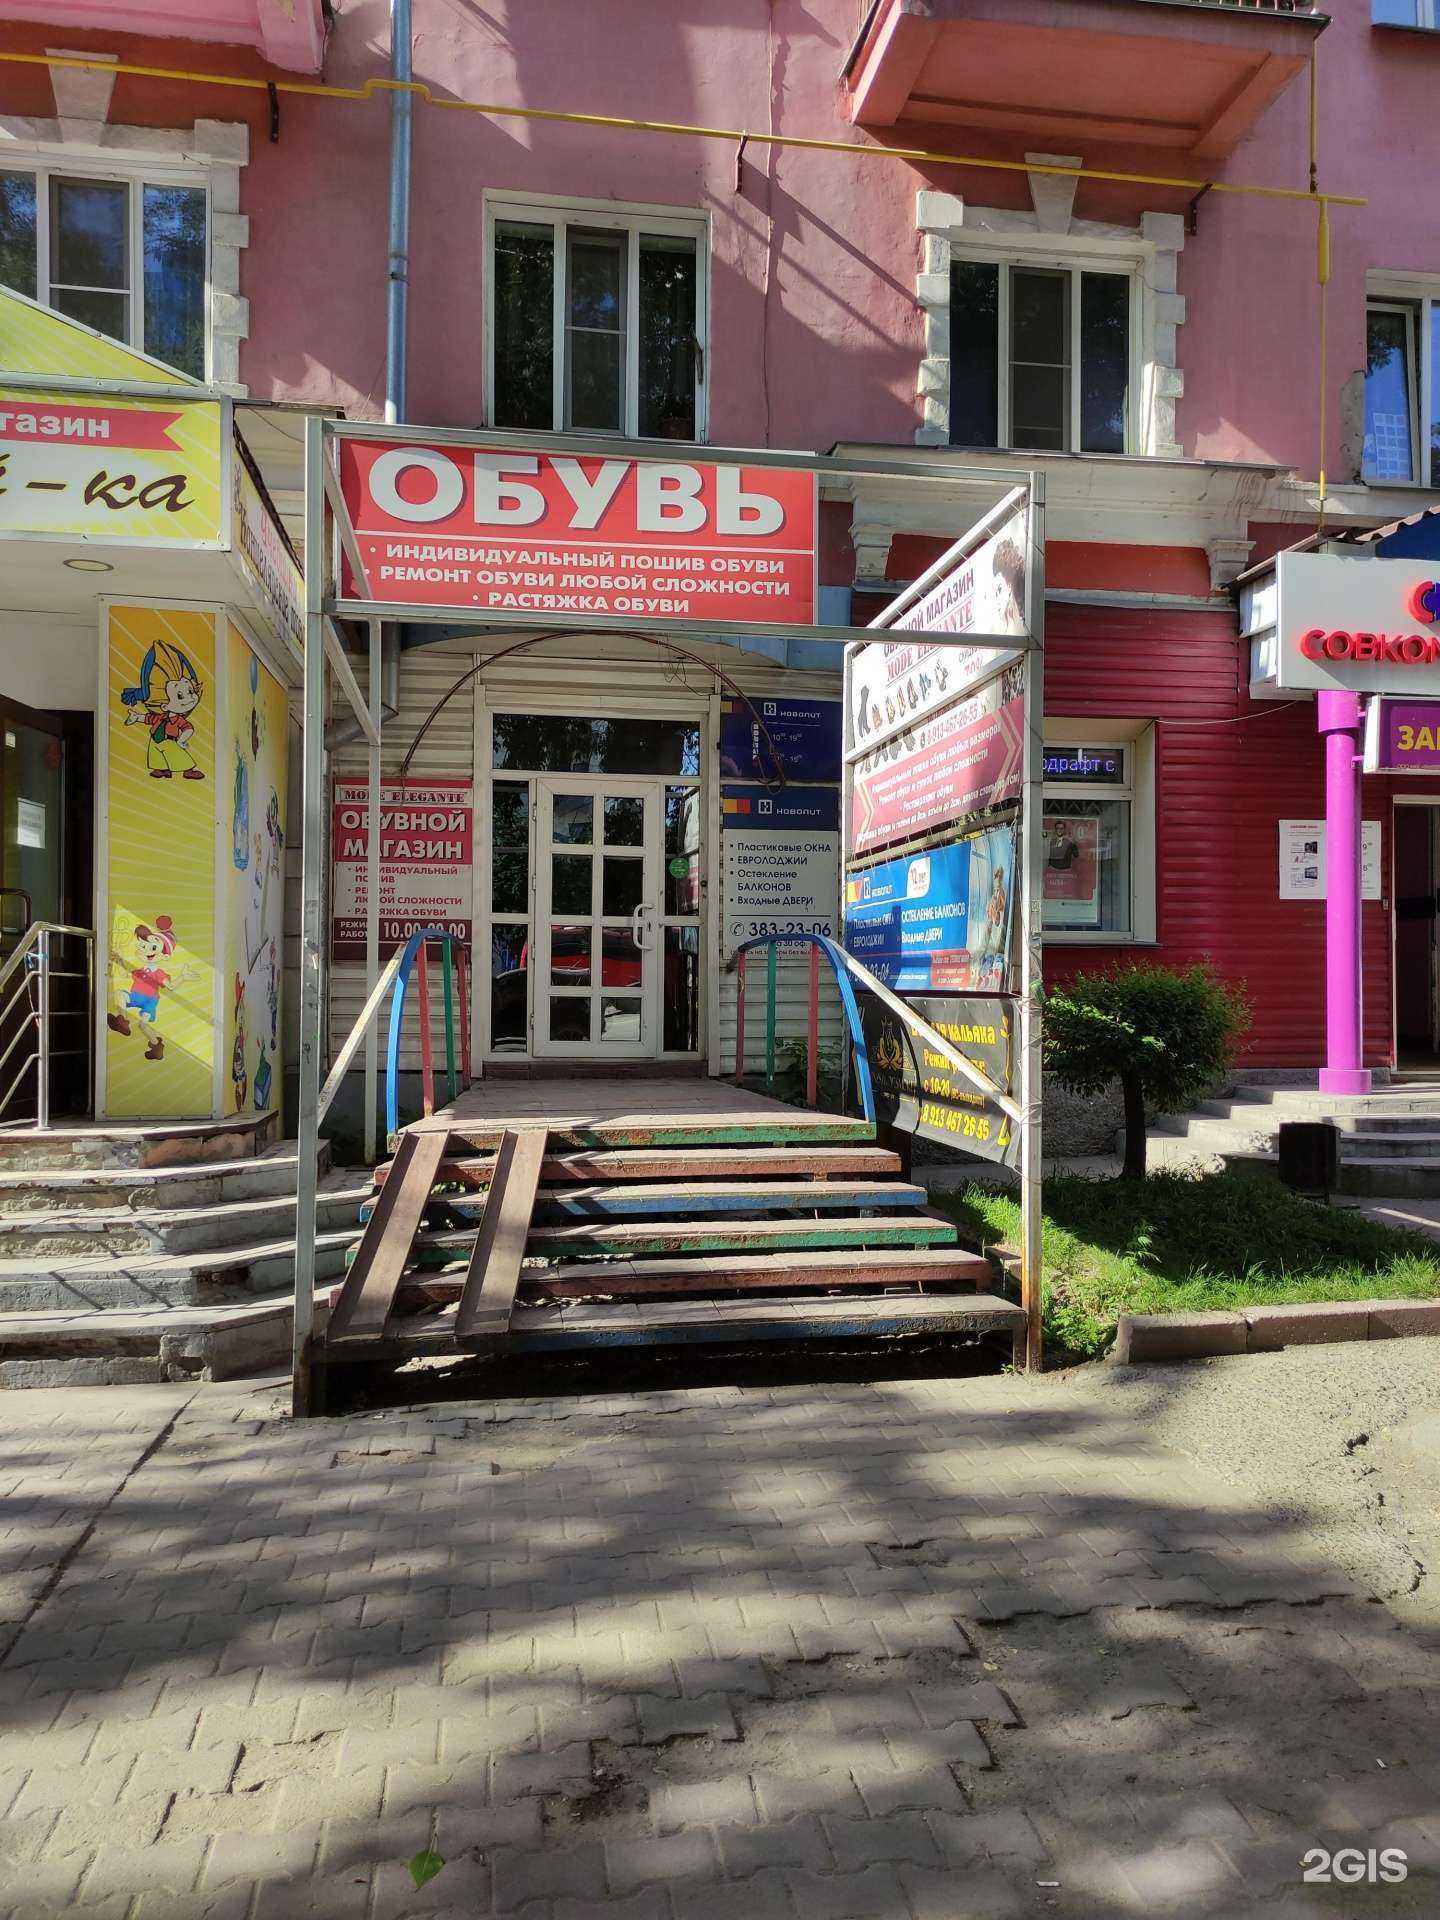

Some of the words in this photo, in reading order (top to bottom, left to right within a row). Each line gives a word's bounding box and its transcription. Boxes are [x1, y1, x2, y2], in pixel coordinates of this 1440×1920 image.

[369, 447, 785, 536] ОБУВЬ
[386, 544, 615, 568] ИНДИВИДУАЛЬНЫЙ
[620, 555, 705, 571] ПОШИВ
[710, 558, 784, 574] ОБУВИ
[380, 566, 471, 584] РЕМОНТ
[476, 570, 554, 587] ОБУВИ
[560, 574, 646, 592] ЛЮБОЙ
[652, 577, 790, 596] СЛОЖНОСТИ
[488, 592, 608, 610] РАСТЯЖКА
[613, 596, 689, 613] ОБУВИ
[926, 567, 974, 624] МАГАЗИН
[1397, 725, 1440, 751] ЗА
[345, 790, 385, 800] MOE
[392, 791, 465, 803] ELEGANTE
[343, 839, 463, 859] МГАЗИН
[738, 843, 802, 851] Пластиковые
[804, 844, 832, 852] ОКНА
[738, 856, 808, 865] ЕВРОЛОДЖИИ
[355, 866, 457, 875] ИНИВИДУАЛЬНЫЙ
[738, 869, 798, 878] Остекление
[738, 883, 792, 891] БАЛКОНОВ
[398, 897, 462, 905] СЛОЖНОСТИ
[738, 896, 780, 905] Входные
[783, 897, 813, 905] ДВЕРИ
[355, 908, 409, 916] РАЯЖКА
[948, 1023, 996, 1044] кальяна
[929, 1105, 945, 1128] 913
[963, 1115, 976, 1136] 26
